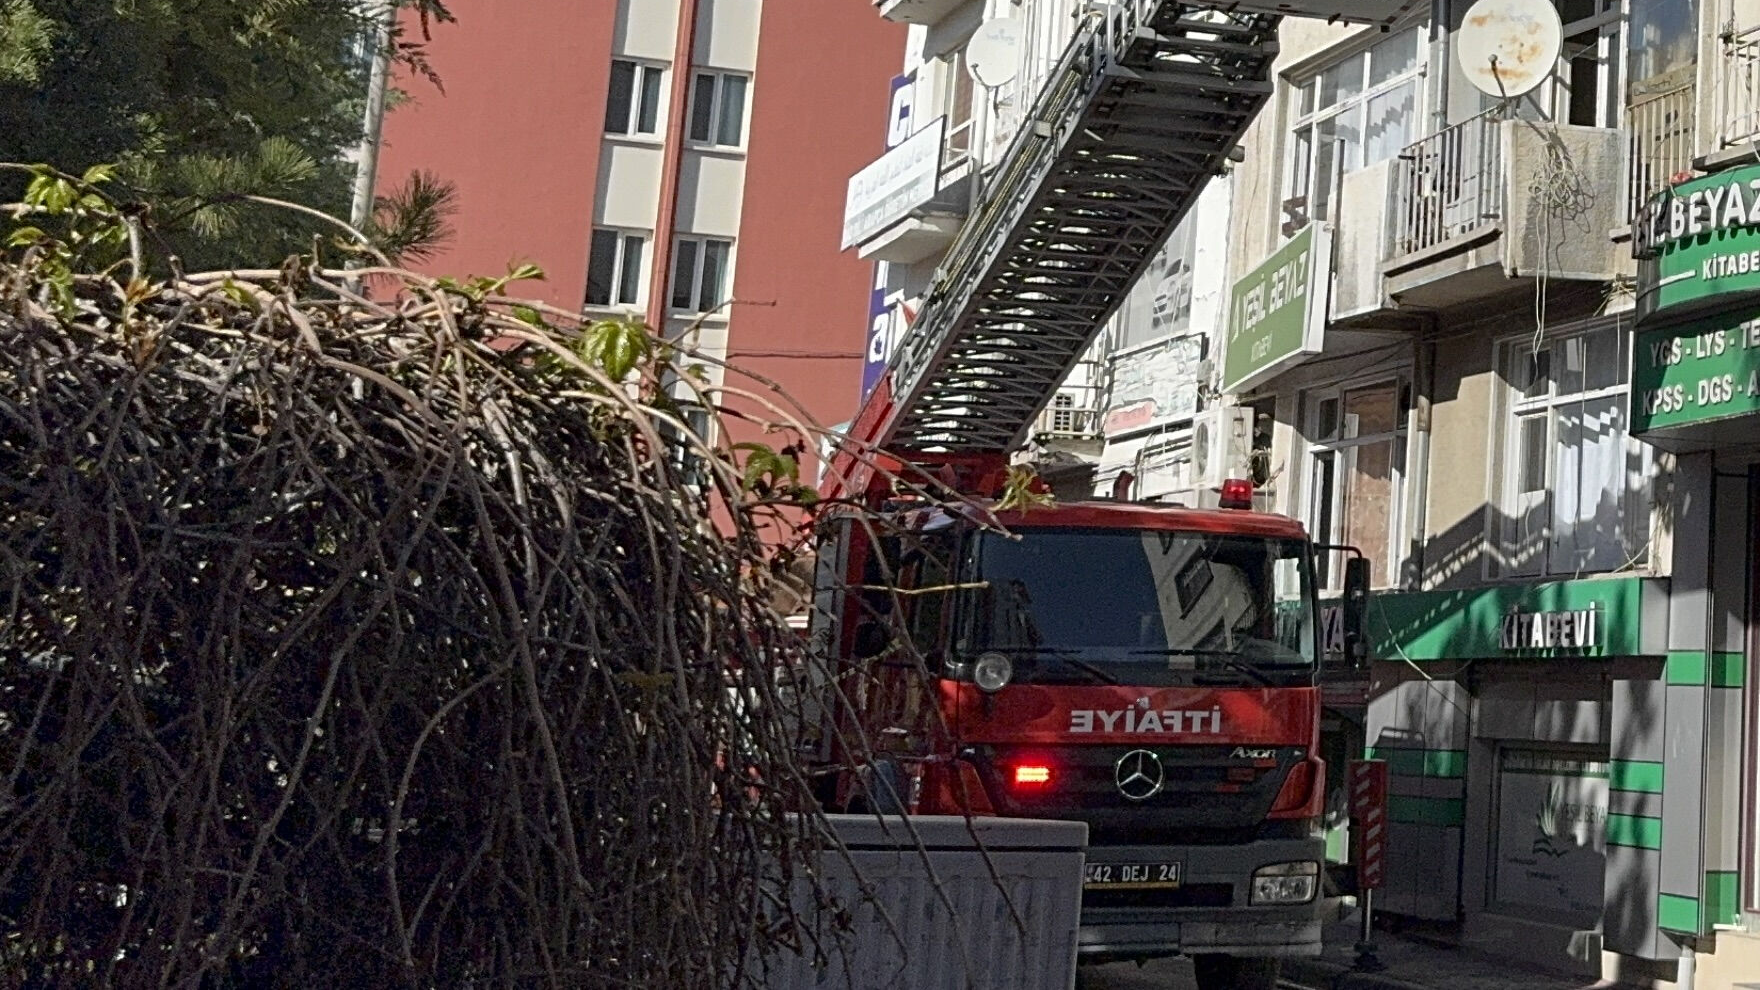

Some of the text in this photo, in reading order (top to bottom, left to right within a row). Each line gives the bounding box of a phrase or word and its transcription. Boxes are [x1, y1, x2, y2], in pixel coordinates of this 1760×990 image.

[1269, 250, 1308, 313] BEYAZ
[1696, 330, 1725, 359] LYS
[1642, 384, 1683, 416] KPSS
[1697, 374, 1733, 406] DGS
[1499, 601, 1597, 648] KİTABEVİ
[1094, 864, 1177, 882] 42 DEJ 24
